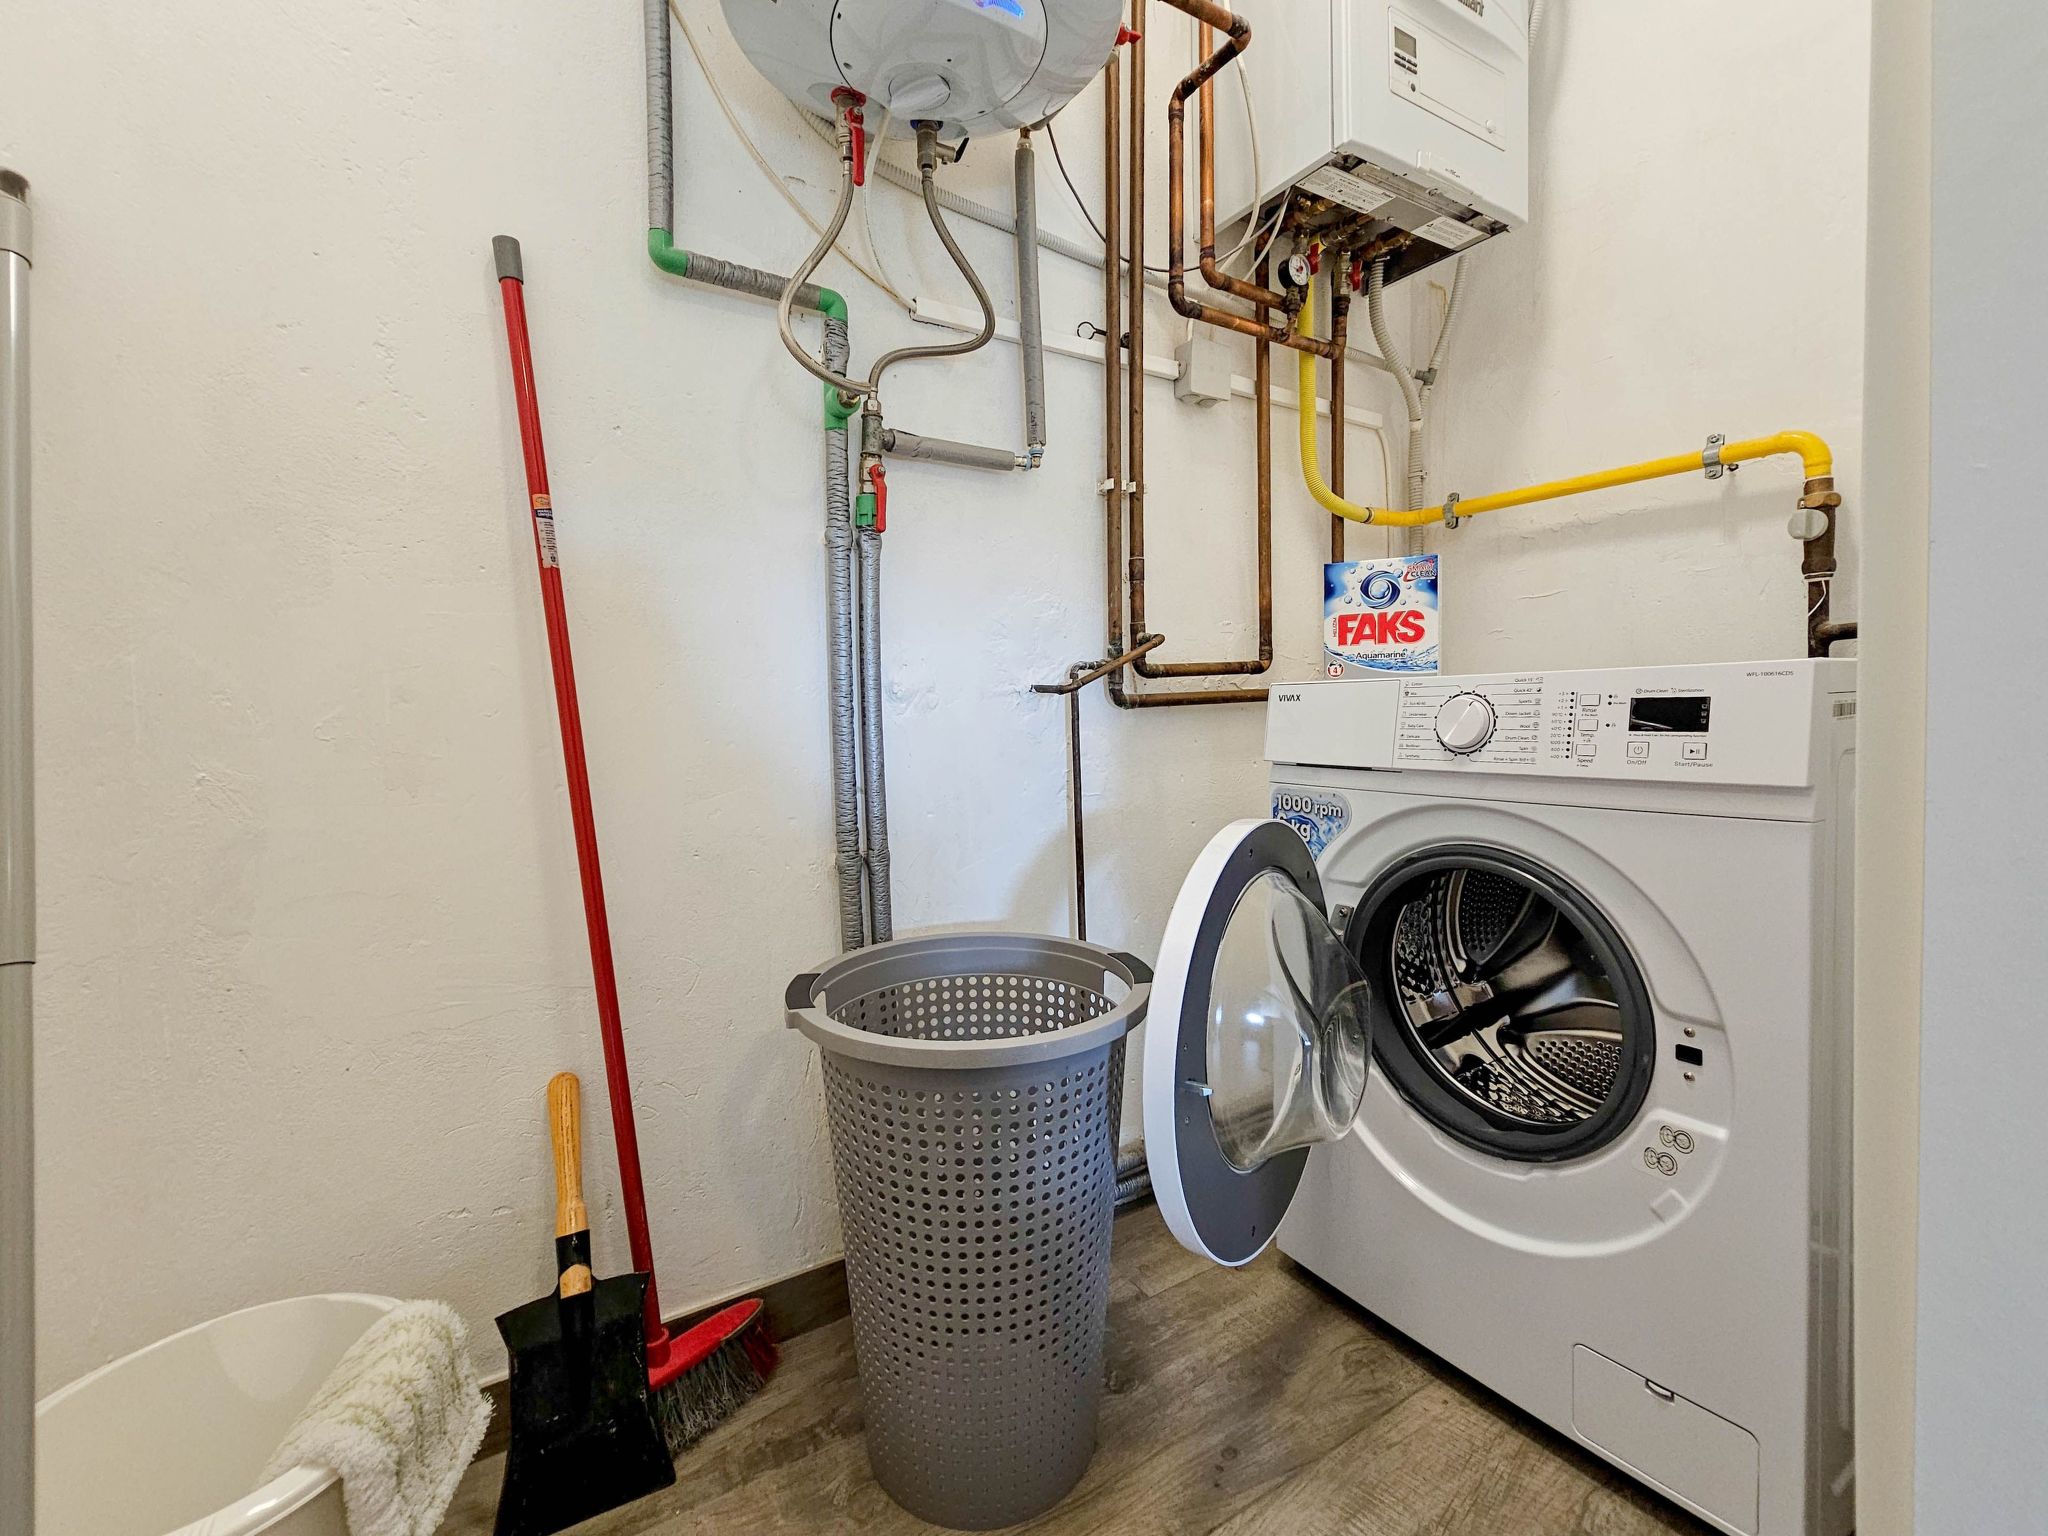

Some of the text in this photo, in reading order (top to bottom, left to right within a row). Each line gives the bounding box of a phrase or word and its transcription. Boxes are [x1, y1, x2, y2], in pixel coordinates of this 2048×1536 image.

[1411, 569, 1436, 577] CLEAN
[1338, 610, 1425, 646] FAKS
[1356, 650, 1406, 661] Aquamarine
[1278, 694, 1301, 702] VIVAX
[1276, 794, 1342, 820] 1000 rpm
